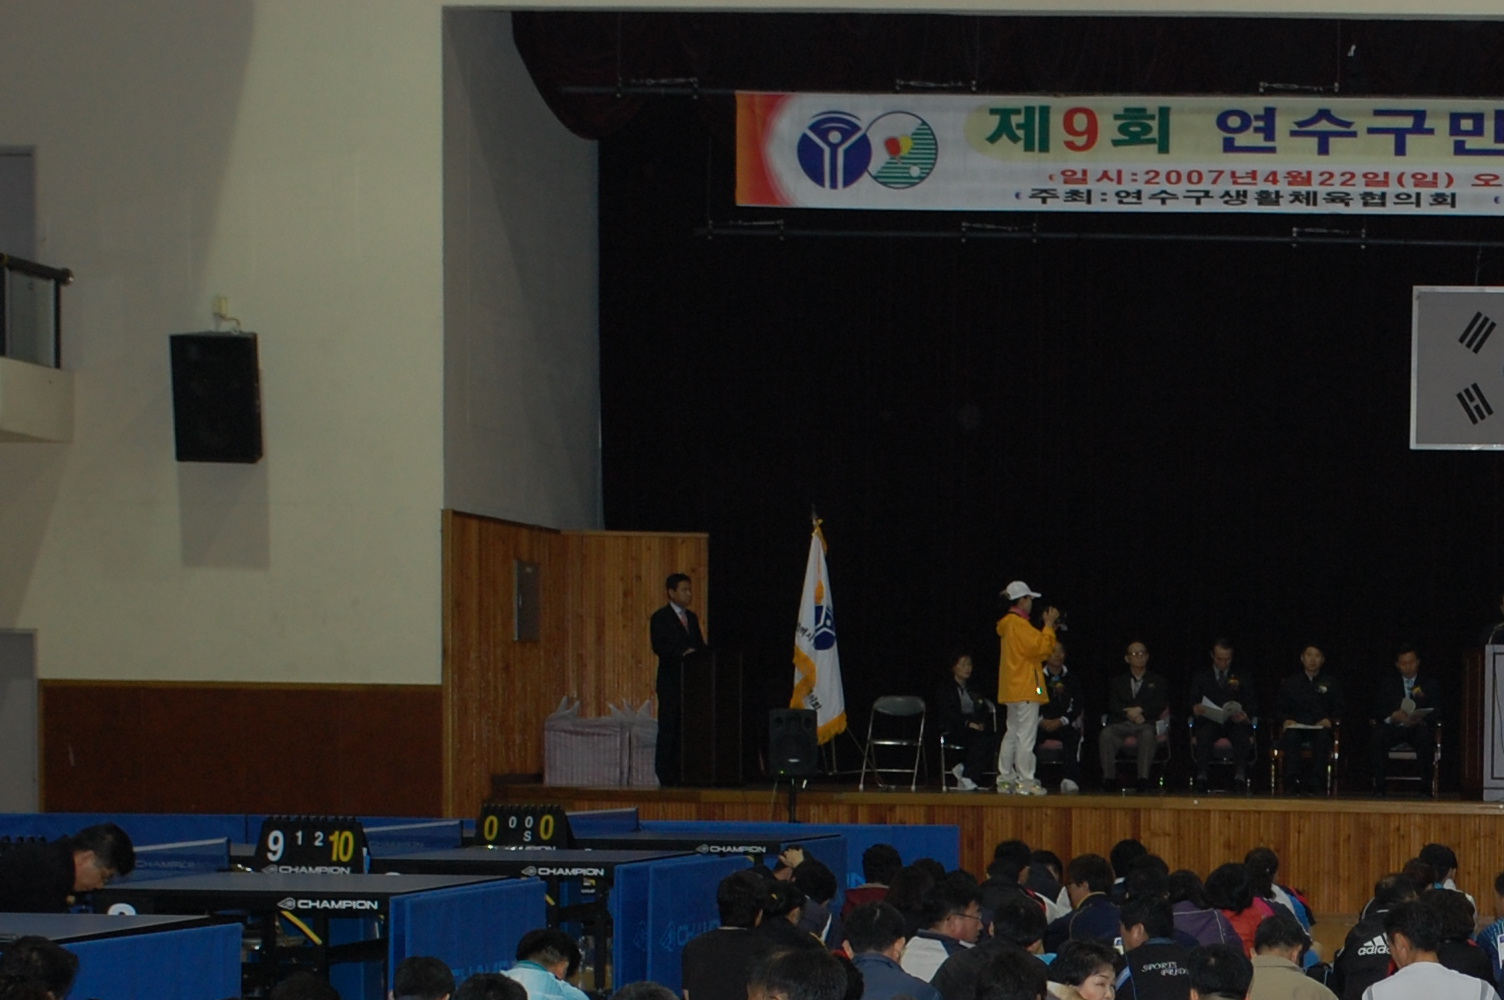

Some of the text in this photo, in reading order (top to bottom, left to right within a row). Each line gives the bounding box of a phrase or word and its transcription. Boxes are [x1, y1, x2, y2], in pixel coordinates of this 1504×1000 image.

[985, 104, 1171, 155] 제9회
[1060, 168, 1455, 189] 일시:2007년4월22일(일)
[1028, 188, 1458, 209] 주최:연수구생활체육협의회
[484, 815, 554, 840] 0 0 0 0
[523, 831, 532, 842] S
[266, 830, 354, 862] 9 1 2 10
[279, 865, 351, 875] CHAMPION
[538, 867, 605, 877] CHAMPION
[297, 898, 378, 911] CHAMPION
[1358, 945, 1391, 956] adid
